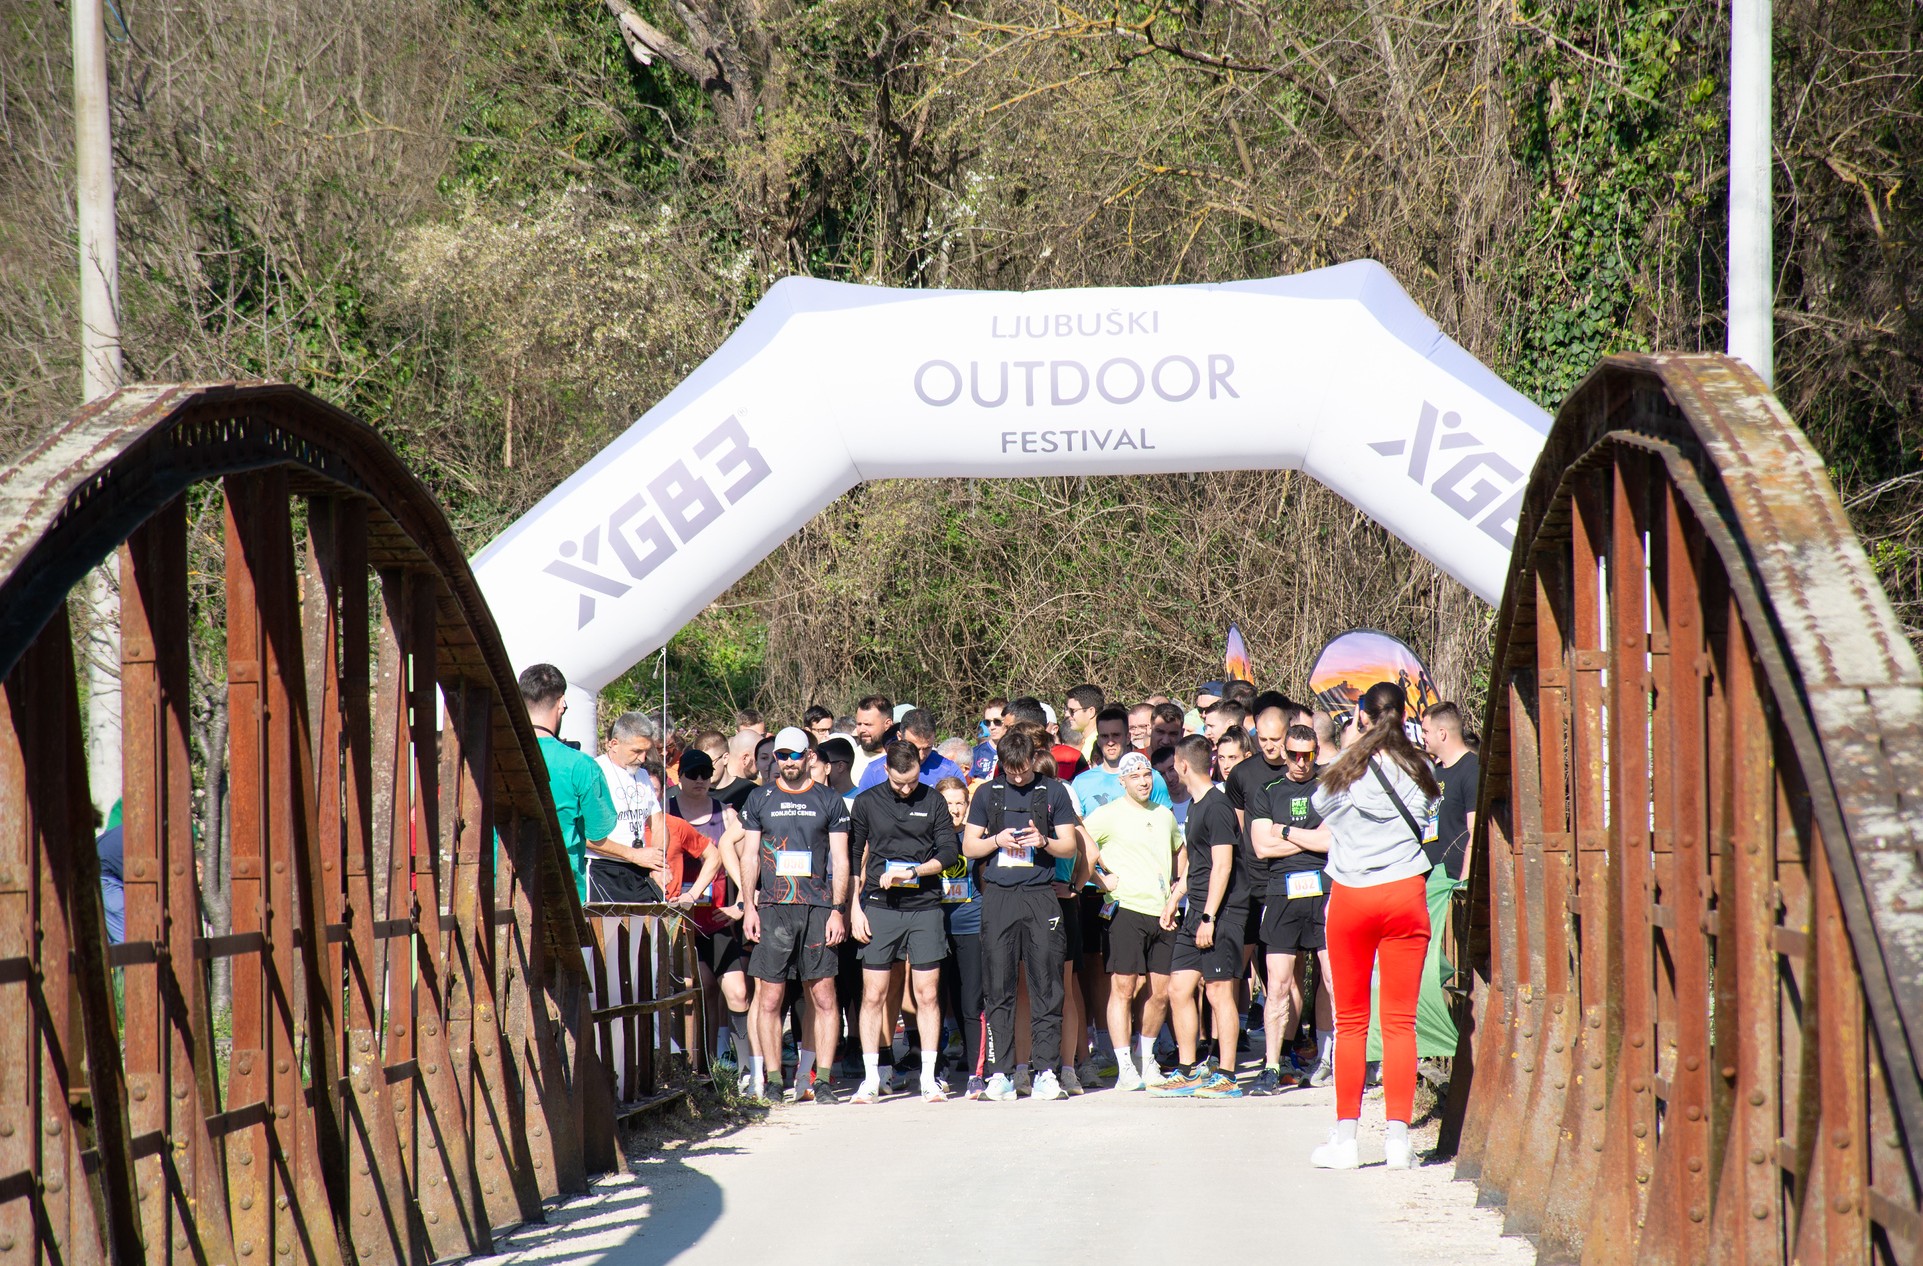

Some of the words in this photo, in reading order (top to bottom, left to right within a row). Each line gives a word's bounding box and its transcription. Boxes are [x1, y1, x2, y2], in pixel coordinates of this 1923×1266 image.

[991, 308, 1159, 339] LJUBUŠKI
[913, 353, 1240, 408] OUTDOOR
[1001, 428, 1155, 453] FESTIVAL
[786, 802, 807, 810] Bingo
